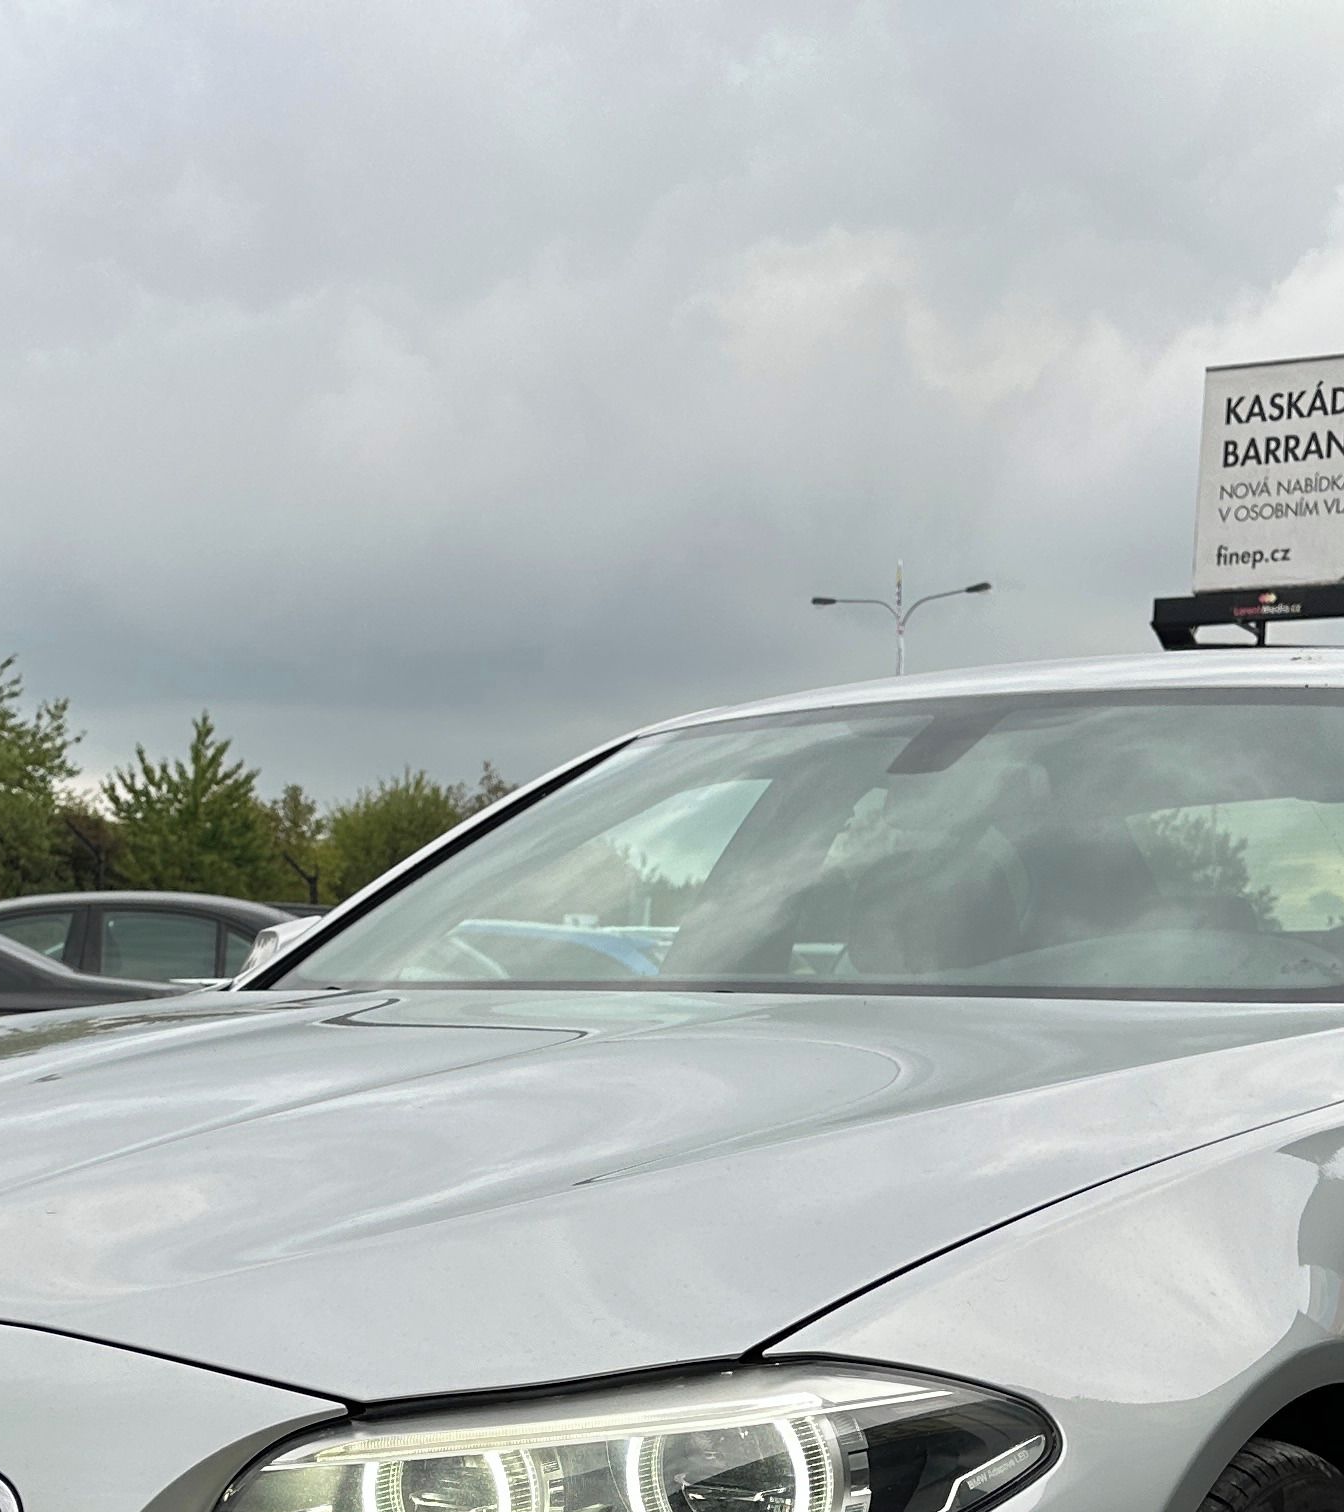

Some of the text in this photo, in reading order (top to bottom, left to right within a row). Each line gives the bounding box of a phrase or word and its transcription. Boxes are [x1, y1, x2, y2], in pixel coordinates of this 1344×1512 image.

[1218, 477, 1271, 501] NOVÁ
[1218, 504, 1231, 521] V
[1234, 496, 1320, 520] OSOBNÍM
[1216, 544, 1291, 569] finep.cz
